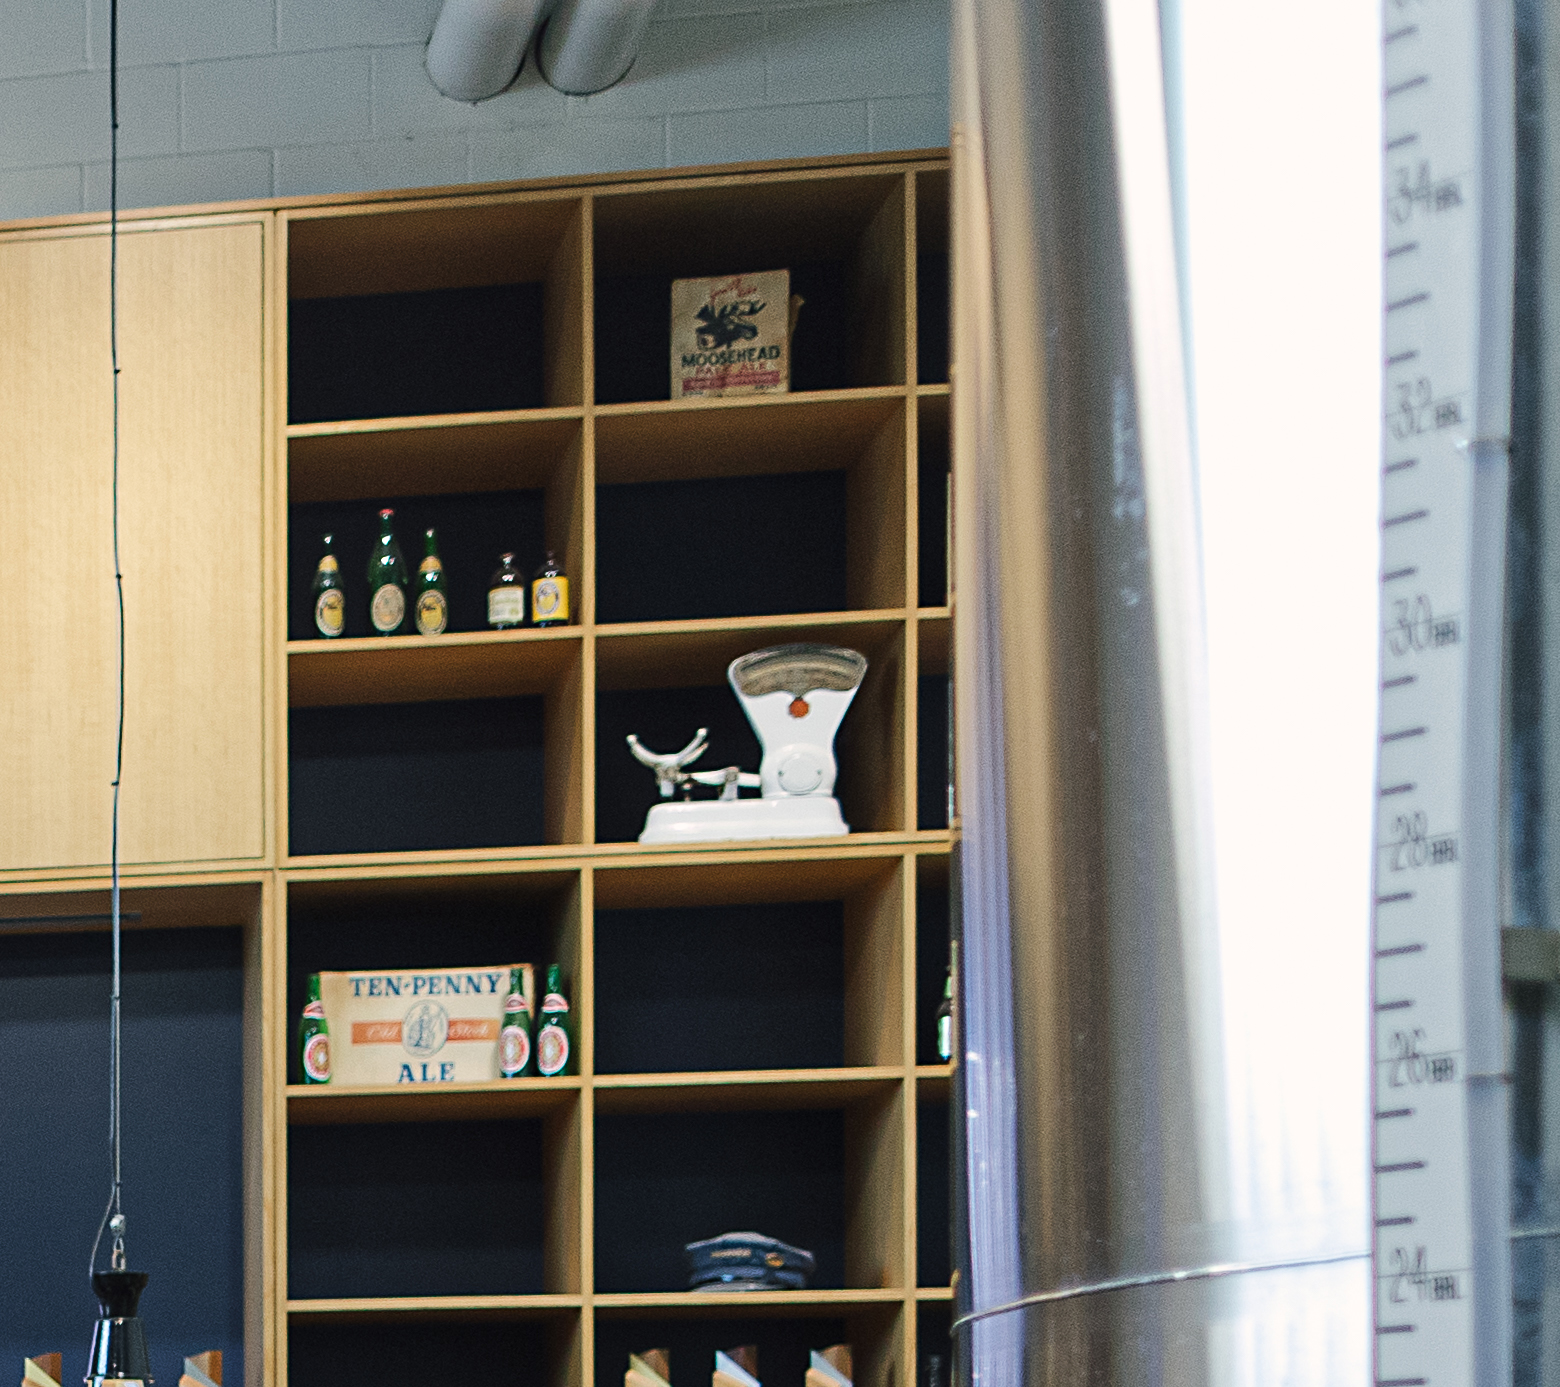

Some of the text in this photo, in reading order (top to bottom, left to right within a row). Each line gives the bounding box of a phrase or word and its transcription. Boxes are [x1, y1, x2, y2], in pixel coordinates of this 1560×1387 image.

[681, 345, 780, 367] MOOSEHEAD
[349, 973, 503, 997] TEN-PENNY
[398, 1063, 454, 1084] ALE
